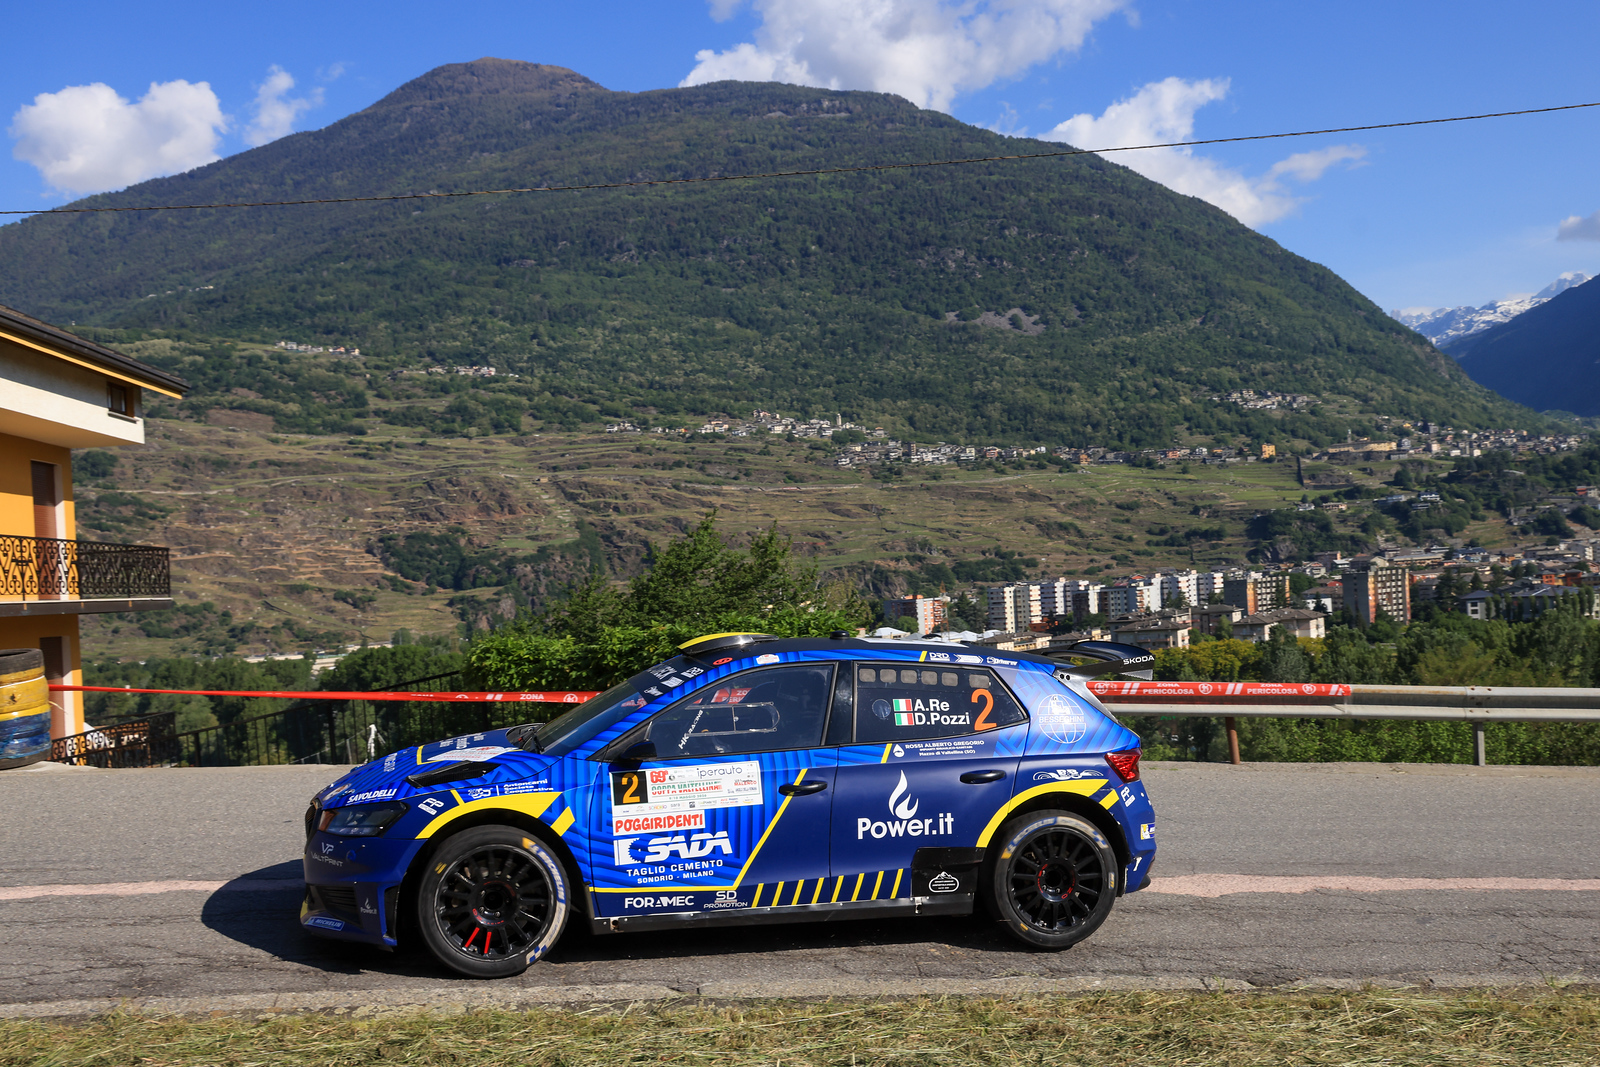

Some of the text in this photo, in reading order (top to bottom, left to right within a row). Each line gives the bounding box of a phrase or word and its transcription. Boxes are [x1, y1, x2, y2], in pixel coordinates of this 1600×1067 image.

[914, 699, 950, 711] A.Re
[971, 688, 997, 731] 2
[914, 712, 970, 725] D.Pozzi
[1039, 715, 1084, 723] BESSEGHINI
[696, 765, 743, 779] iperauto
[621, 772, 641, 804] 2
[347, 788, 398, 803] SAVOLDELLI
[615, 813, 703, 833] POGGIRIDENTI
[857, 812, 954, 840] Power.it
[644, 830, 733, 863] SADA
[626, 859, 723, 877] TAGLIO CEMENTO
[637, 874, 673, 884] SONDRIO
[682, 870, 714, 879] MILANO
[716, 890, 737, 900] SD
[703, 901, 748, 909] PROMOTION
[315, 918, 343, 927] MICHELIN
